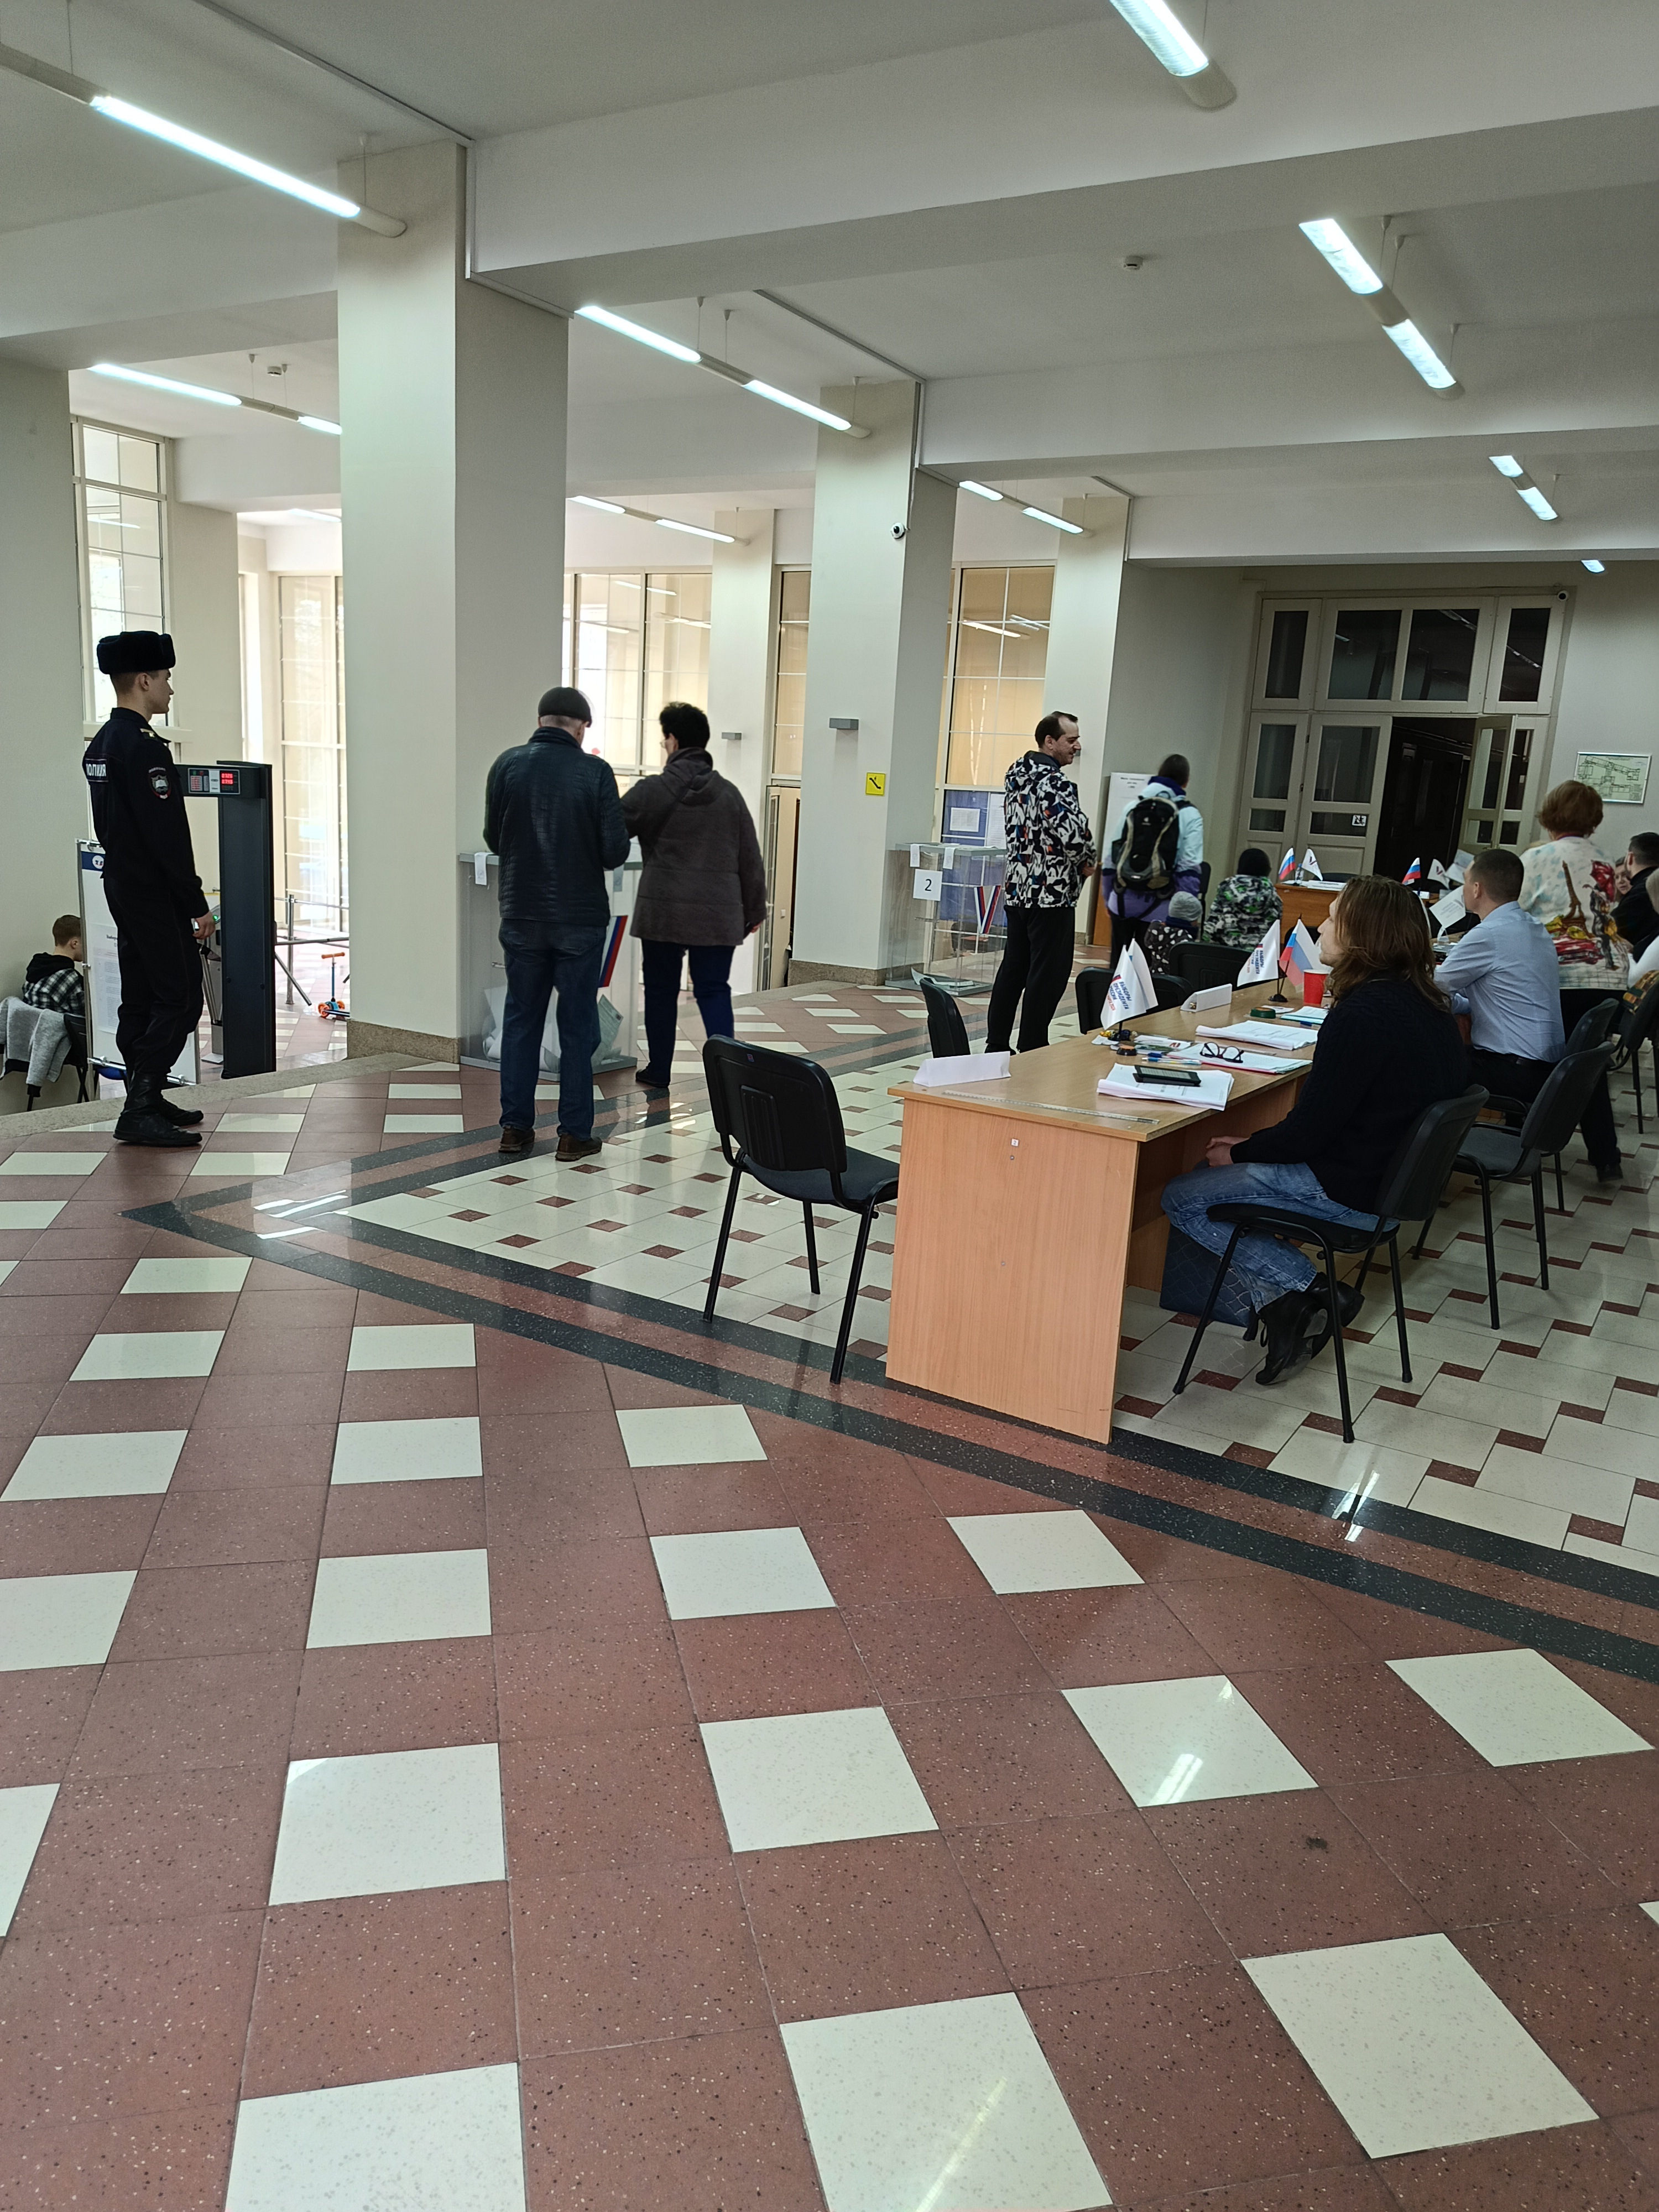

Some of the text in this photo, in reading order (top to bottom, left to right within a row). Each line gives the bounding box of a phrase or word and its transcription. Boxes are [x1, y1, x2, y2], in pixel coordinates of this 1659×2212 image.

[925, 879, 932, 891] 2
[1113, 983, 1129, 1010] ПРЕЗИДЕНТА
[1119, 981, 1133, 1001] ВЫБОРЫ
